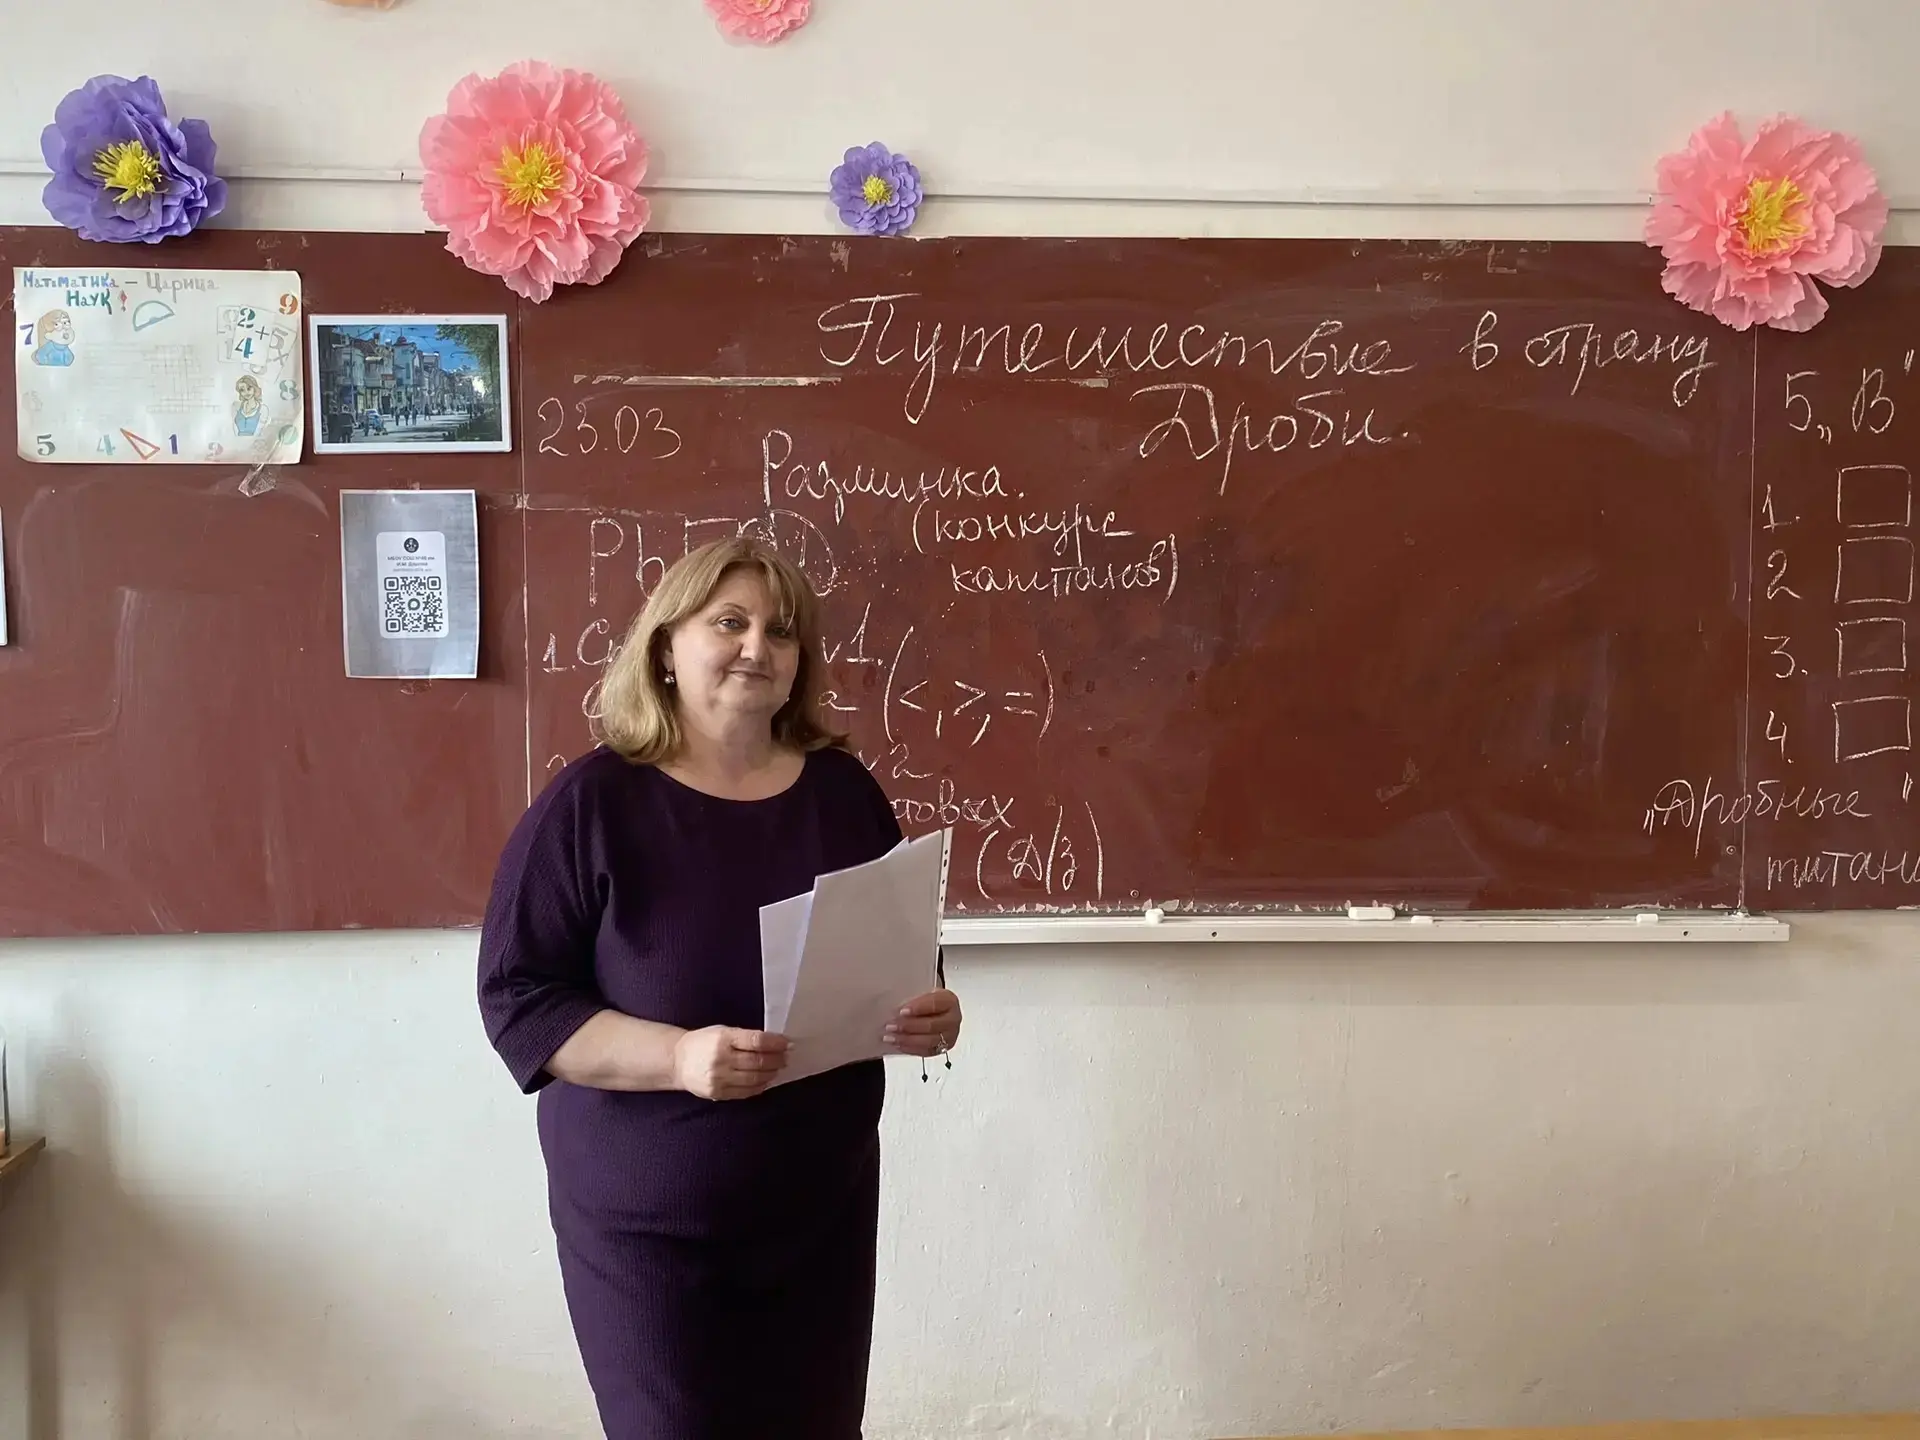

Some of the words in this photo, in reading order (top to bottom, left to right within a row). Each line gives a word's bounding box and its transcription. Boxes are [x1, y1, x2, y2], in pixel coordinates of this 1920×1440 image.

[22, 271, 120, 288] Математика
[818, 293, 1418, 424] Путешествие
[1458, 310, 1500, 371] в
[1524, 322, 1719, 408] страну
[37, 434, 56, 456] 5
[168, 434, 179, 455] 1
[538, 397, 682, 460] 23.03
[1130, 382, 1411, 498] Дроби.
[761, 429, 1025, 526] Разминка.
[1766, 850, 1920, 892] титан
